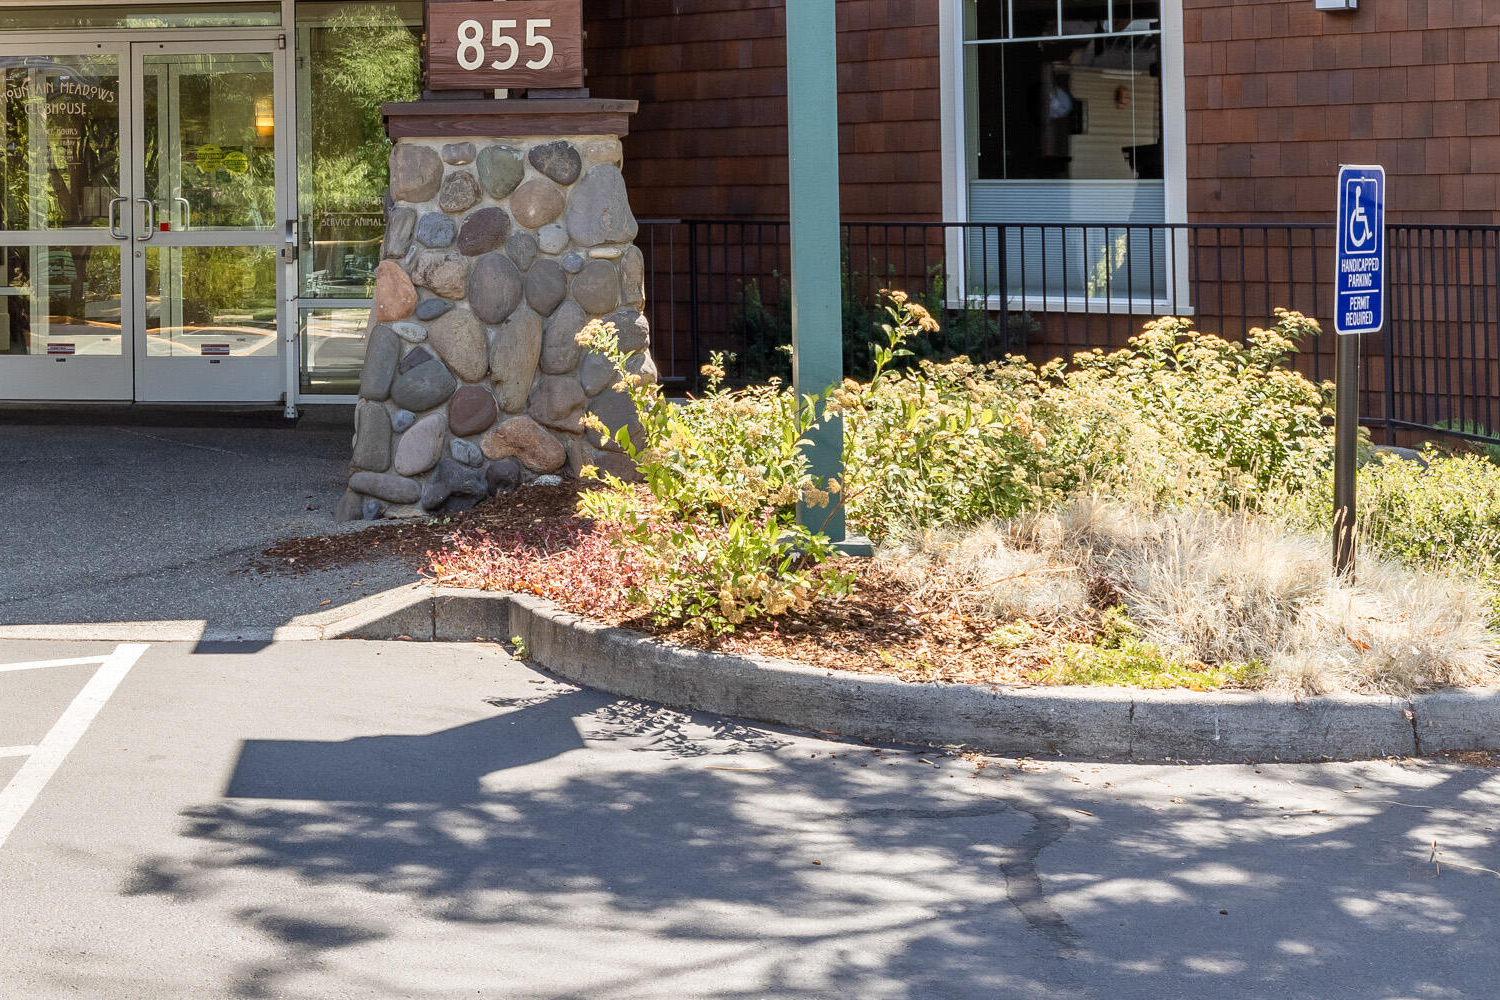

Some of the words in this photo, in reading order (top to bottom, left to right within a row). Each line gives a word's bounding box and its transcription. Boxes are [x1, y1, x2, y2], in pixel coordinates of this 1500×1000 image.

[456, 18, 554, 71] 855
[60, 81, 114, 103] MEADOWS
[321, 218, 351, 227] SERVICE
[1341, 257, 1380, 273] HANDICAPPED
[1348, 272, 1373, 288] PARKING
[1349, 295, 1371, 310] PERMIT
[1345, 310, 1373, 327] REQUIRED
